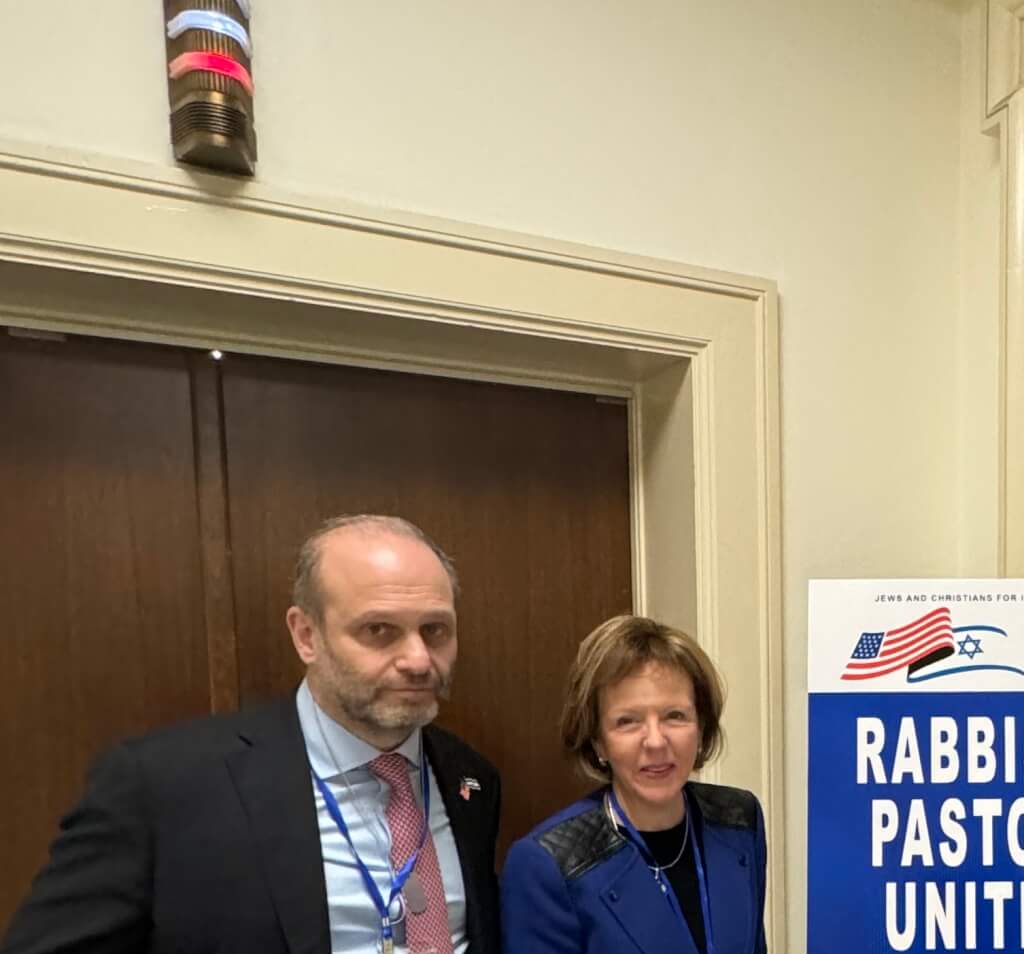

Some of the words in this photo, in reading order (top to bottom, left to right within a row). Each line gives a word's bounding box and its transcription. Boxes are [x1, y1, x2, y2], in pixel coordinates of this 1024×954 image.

[874, 594, 902, 602] JEWS
[906, 594, 927, 602] AND
[931, 594, 993, 602] CHRISTIANS
[996, 594, 1017, 602] FOR
